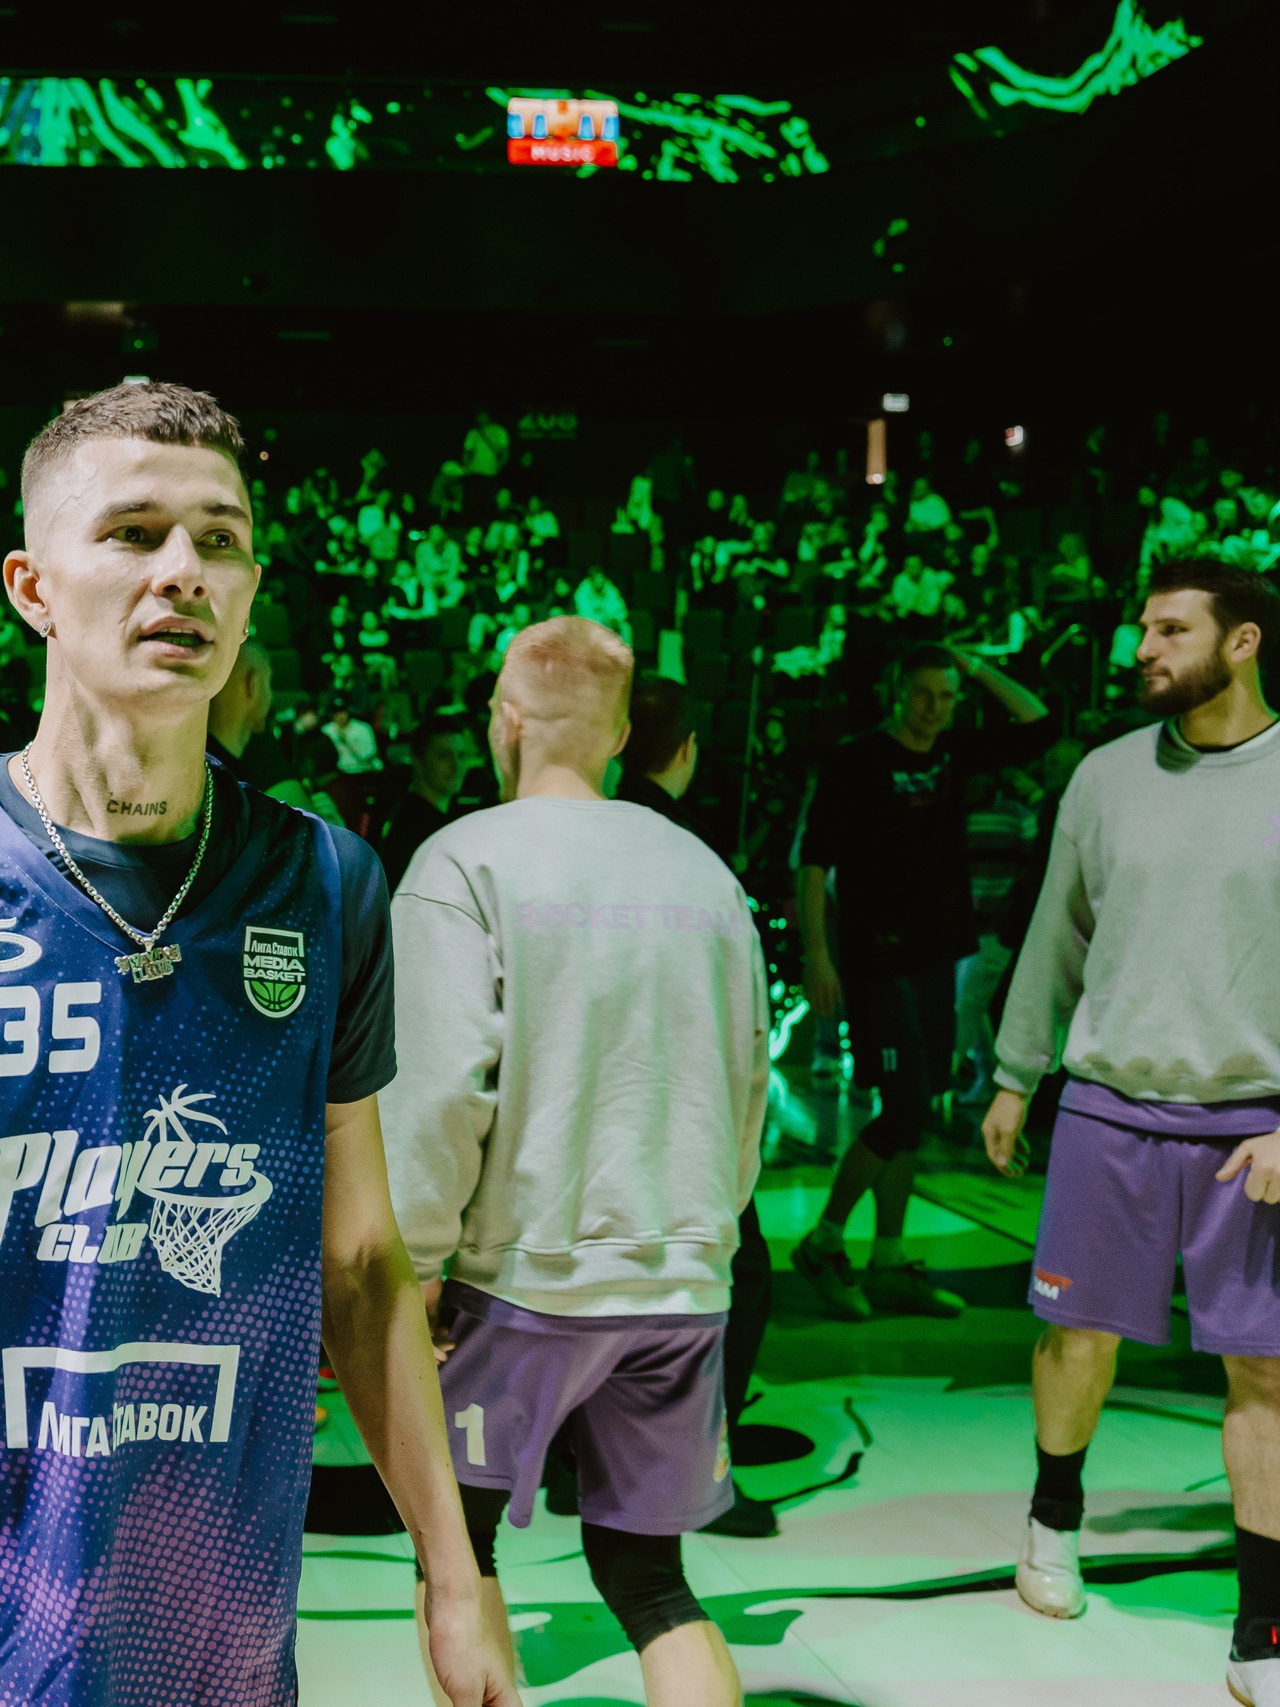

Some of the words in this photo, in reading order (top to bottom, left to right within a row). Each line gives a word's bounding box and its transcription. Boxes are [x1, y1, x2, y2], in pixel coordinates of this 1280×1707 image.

[106, 799, 168, 816] CHAINS
[243, 954, 306, 972] MEDIA
[243, 967, 306, 983] BASKET
[36, 1223, 149, 1264] CLUB
[454, 1402, 487, 1467] 1
